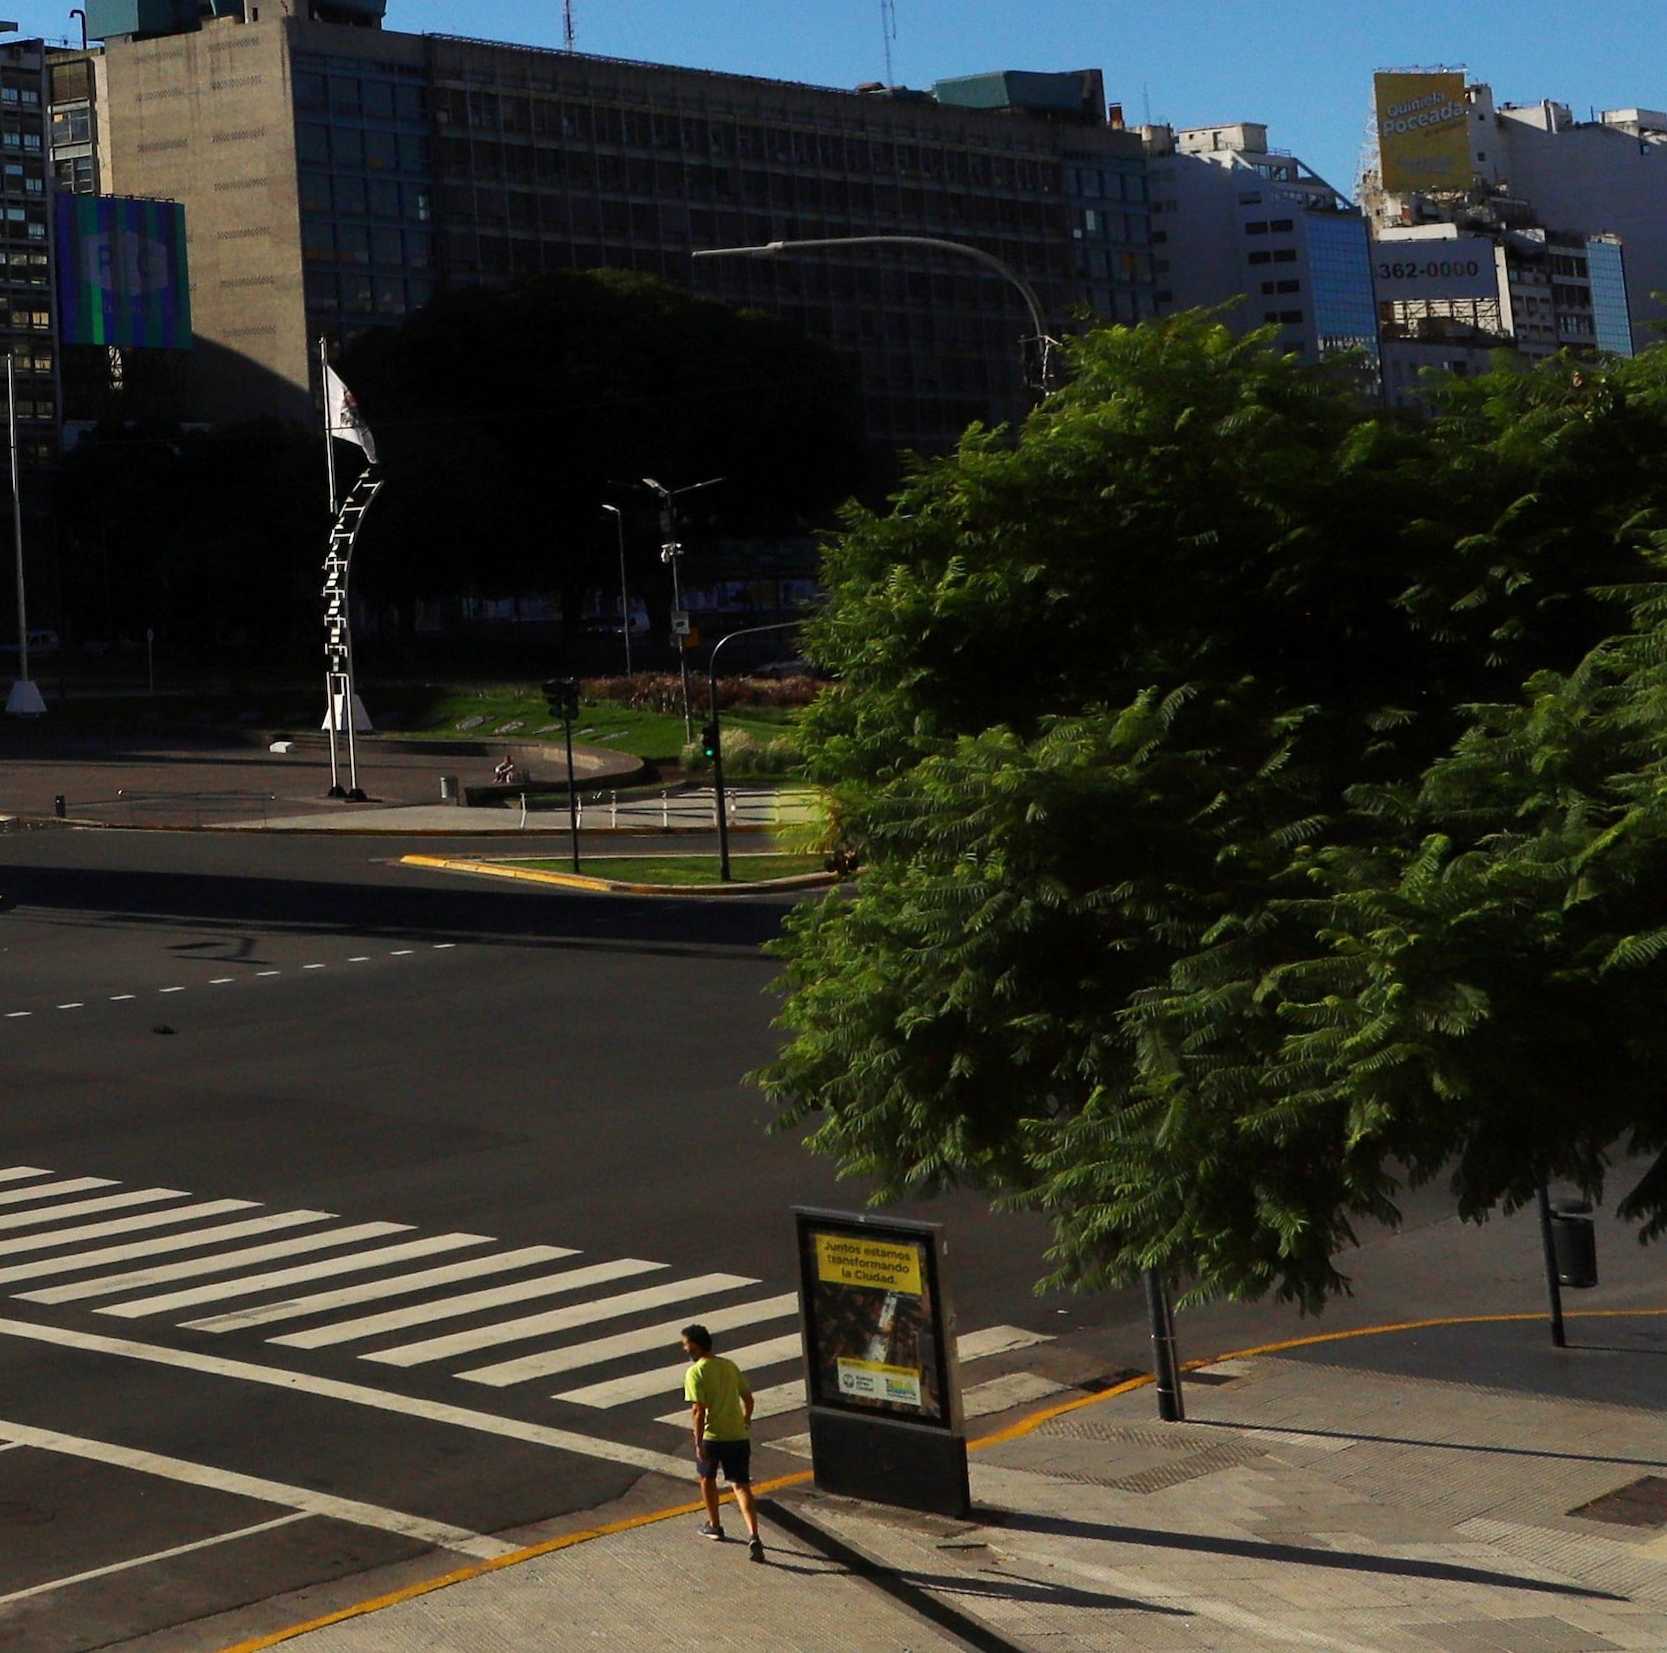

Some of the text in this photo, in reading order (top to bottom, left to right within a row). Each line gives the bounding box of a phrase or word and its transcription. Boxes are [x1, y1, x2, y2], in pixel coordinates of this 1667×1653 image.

[1386, 93, 1445, 118] Quiniela
[1382, 101, 1465, 138] Poceada
[823, 1241, 911, 1261] Juntos estamos
[826, 1253, 910, 1274] transformando
[841, 1267, 852, 1278] la
